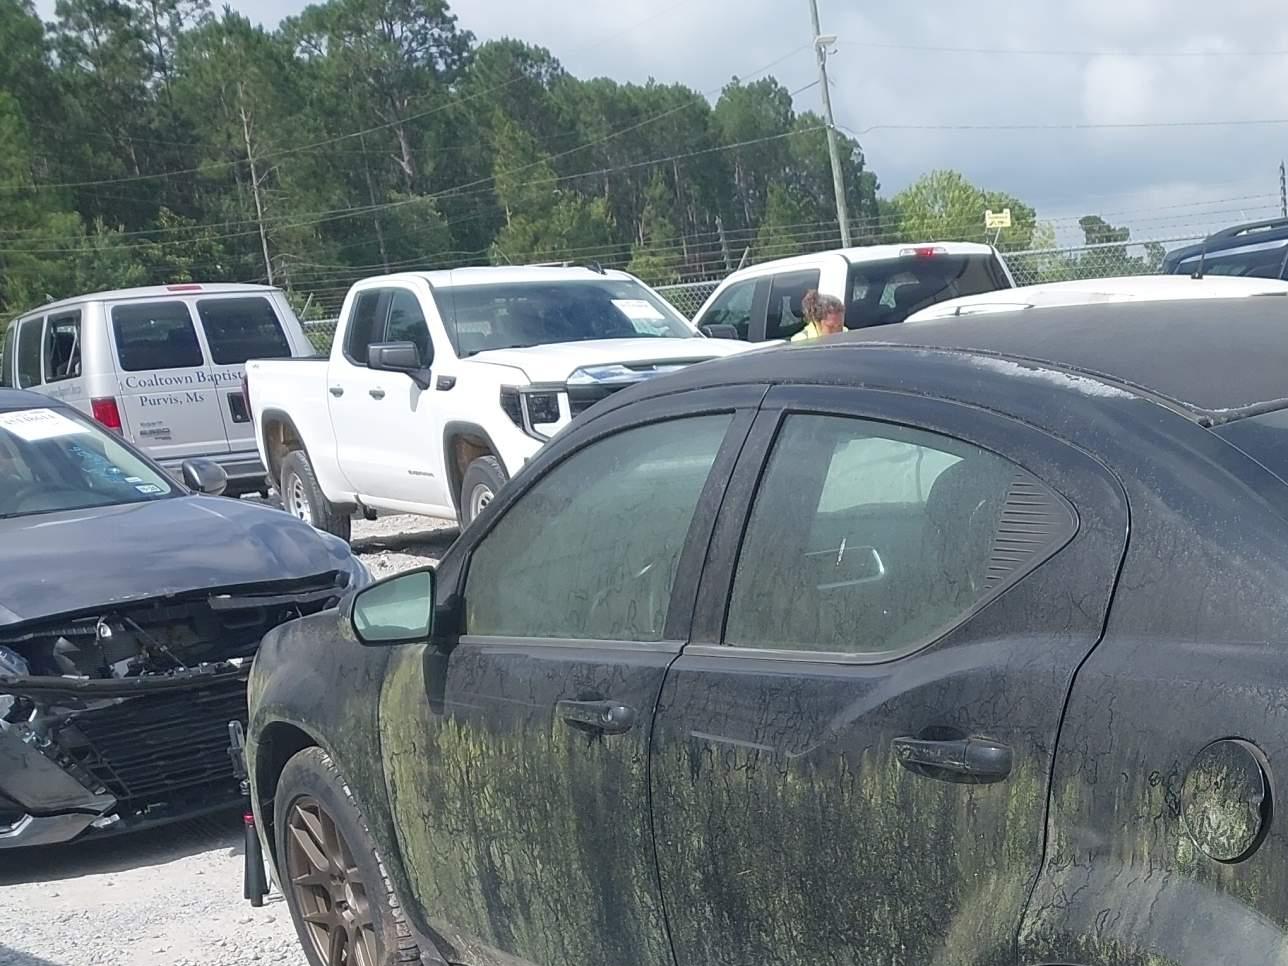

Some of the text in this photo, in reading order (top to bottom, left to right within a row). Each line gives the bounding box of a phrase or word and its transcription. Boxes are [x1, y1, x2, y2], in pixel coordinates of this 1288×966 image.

[126, 370, 243, 388] Coaltown Baptist
[139, 392, 205, 407] Purvis, Ms
